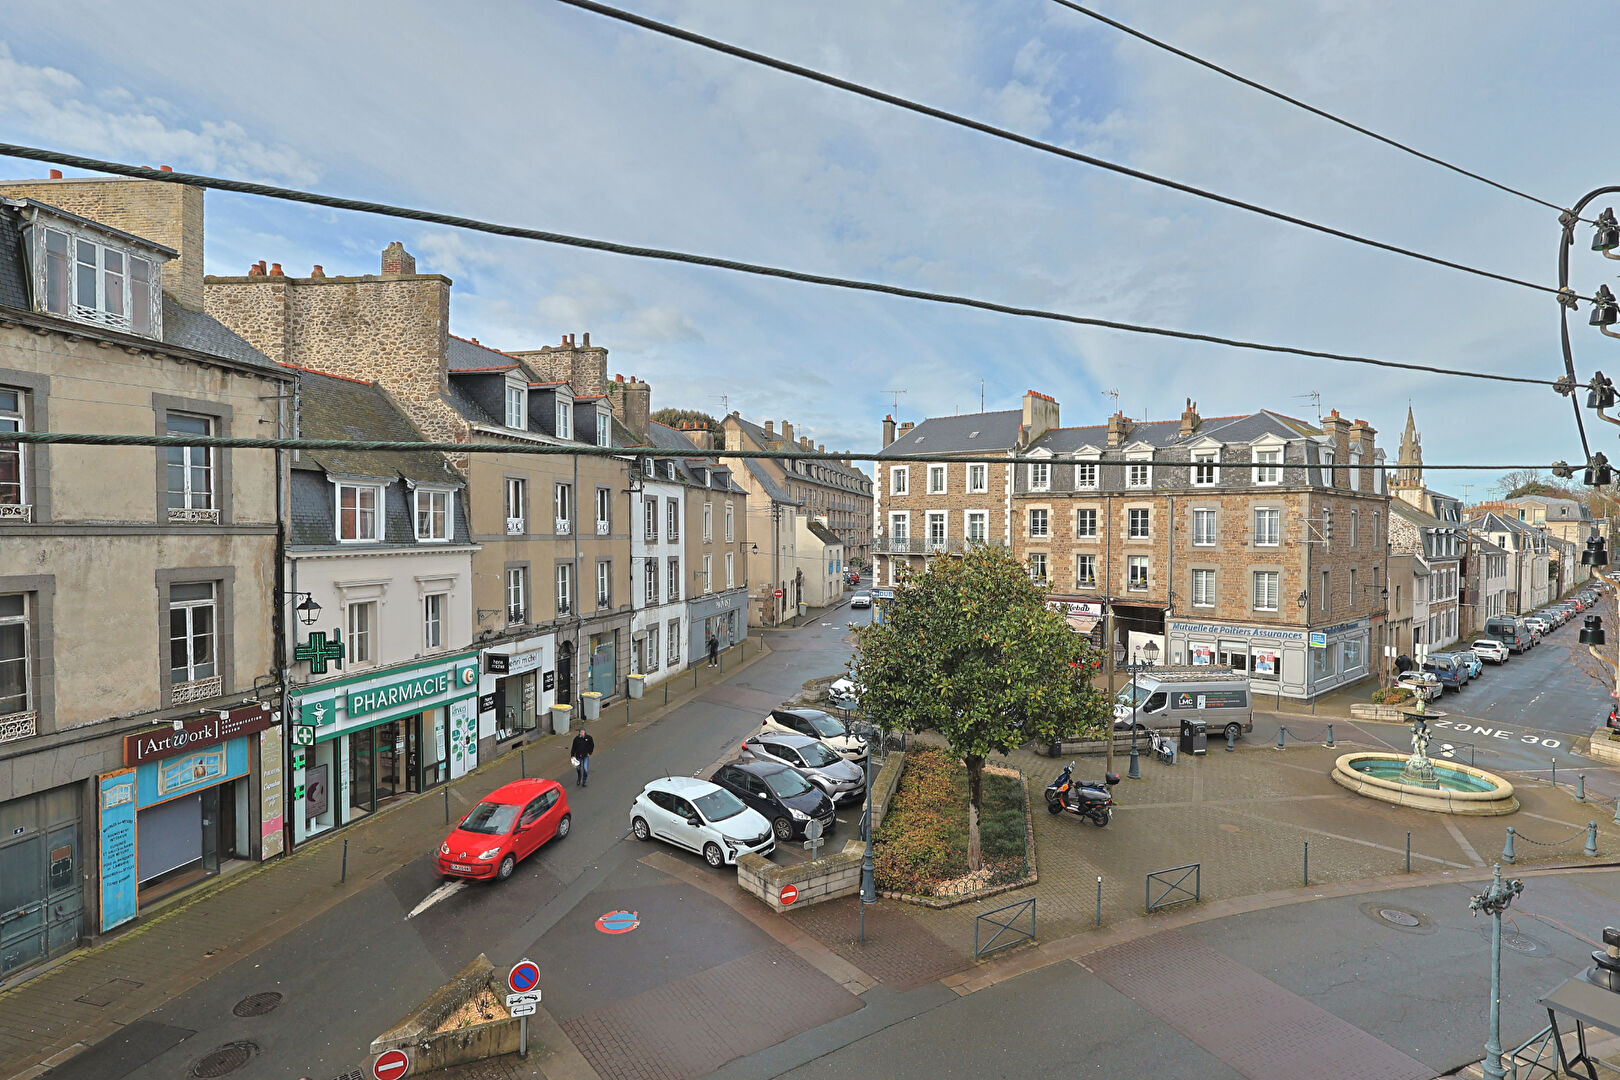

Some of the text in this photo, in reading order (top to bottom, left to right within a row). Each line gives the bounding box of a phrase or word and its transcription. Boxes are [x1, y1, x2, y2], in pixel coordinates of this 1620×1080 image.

[1172, 622, 1208, 632] Mutuelle
[1208, 624, 1218, 633] de
[1220, 626, 1251, 636] Poitiers
[1252, 628, 1303, 640] Assurances
[353, 674, 446, 714] PHARMACIE
[222, 716, 262, 730] COMMUNICATION
[1434, 720, 1560, 748] ZONE 30
